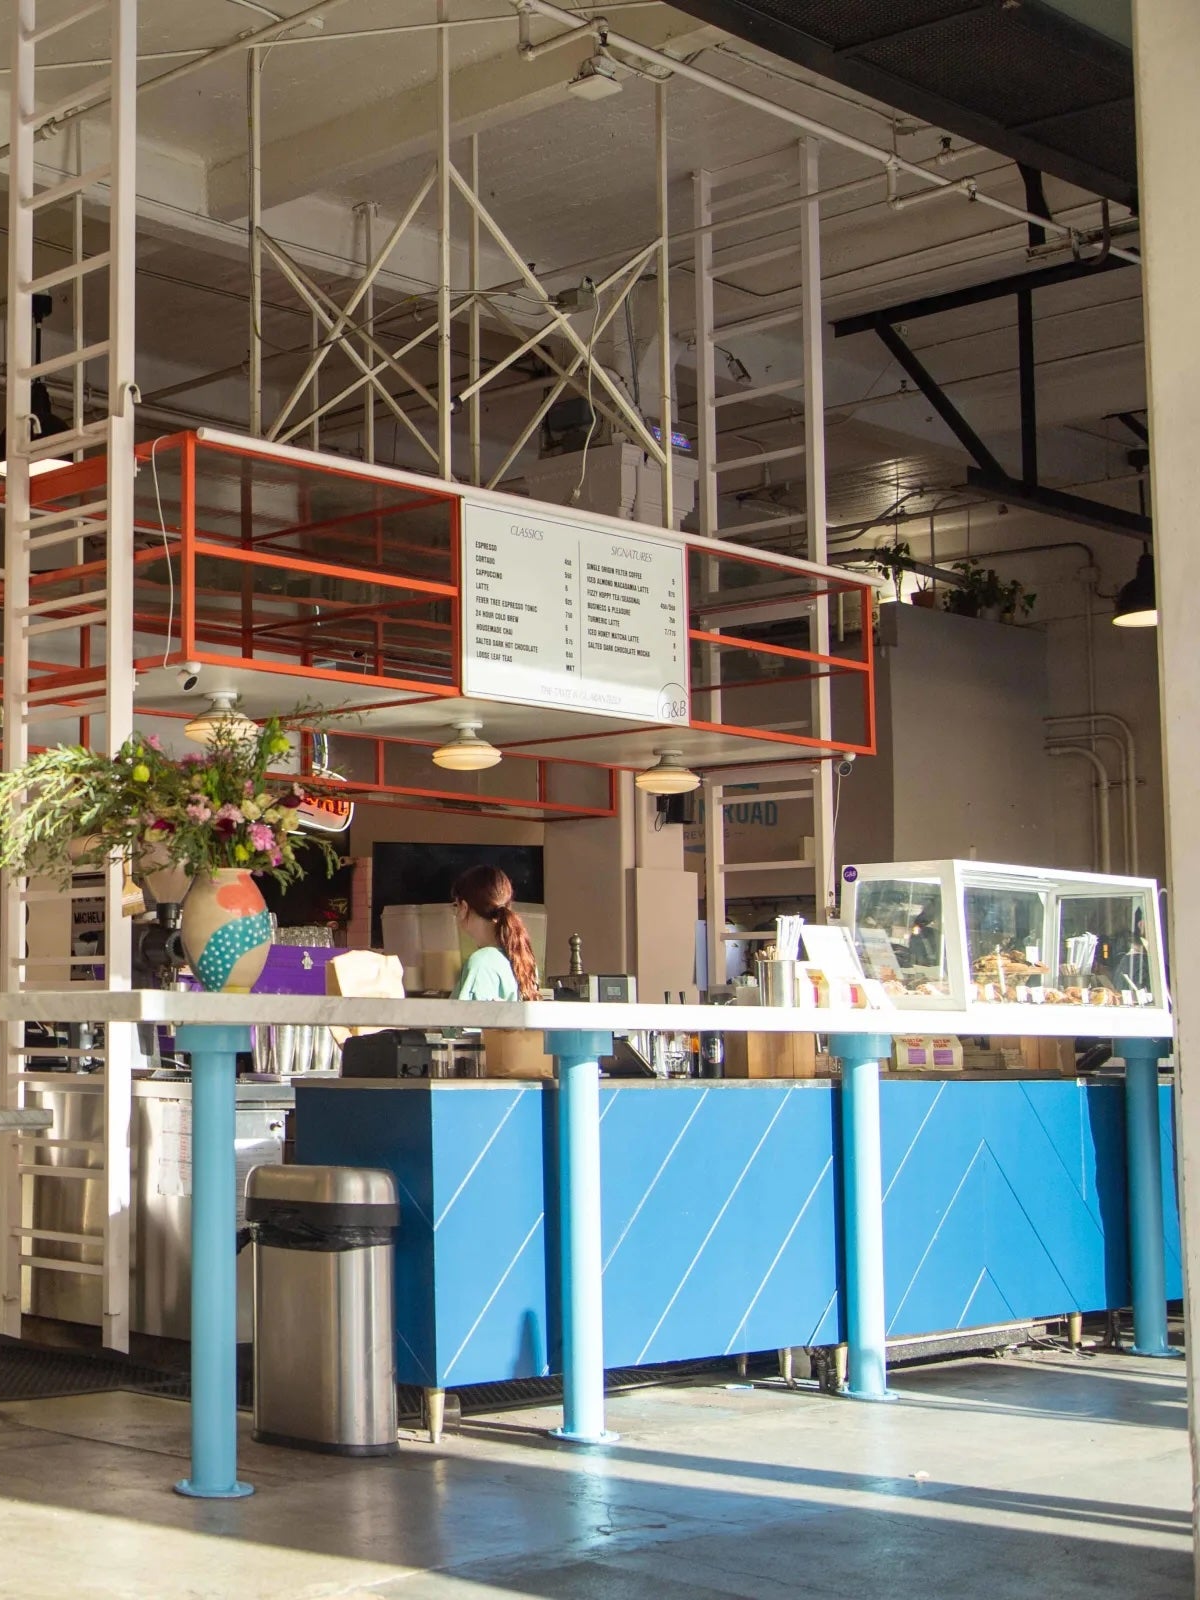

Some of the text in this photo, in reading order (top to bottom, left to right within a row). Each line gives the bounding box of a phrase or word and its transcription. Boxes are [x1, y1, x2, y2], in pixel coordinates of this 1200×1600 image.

[510, 525, 544, 541] CLASSICS
[475, 541, 497, 552] ESPRESSO
[611, 545, 653, 562] SIGNATURES
[475, 568, 503, 580] CAPPUCCINO
[475, 582, 489, 591] LATTE
[637, 585, 649, 594] LATTE
[502, 600, 524, 610] ESPRESSO
[608, 619, 620, 627] LATTE
[628, 635, 640, 643] LATTE
